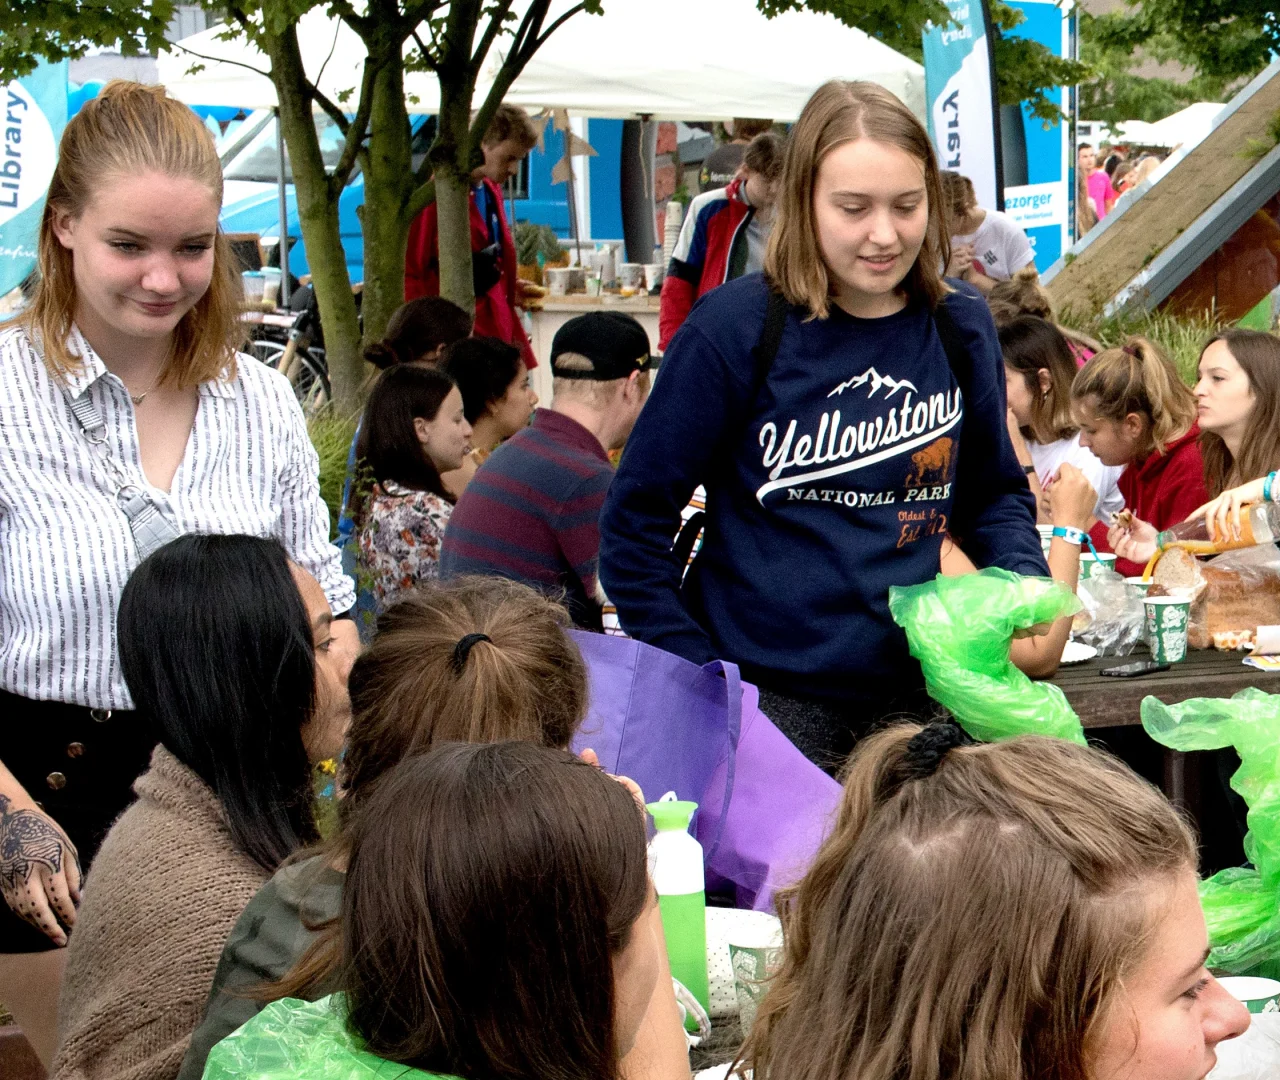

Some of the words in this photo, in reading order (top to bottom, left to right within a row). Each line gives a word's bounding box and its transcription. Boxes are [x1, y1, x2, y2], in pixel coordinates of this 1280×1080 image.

[0, 90, 28, 208] Library
[1005, 193, 1053, 210] ezorger
[787, 487, 896, 508] NATIONAL
[904, 482, 953, 503] PARK
